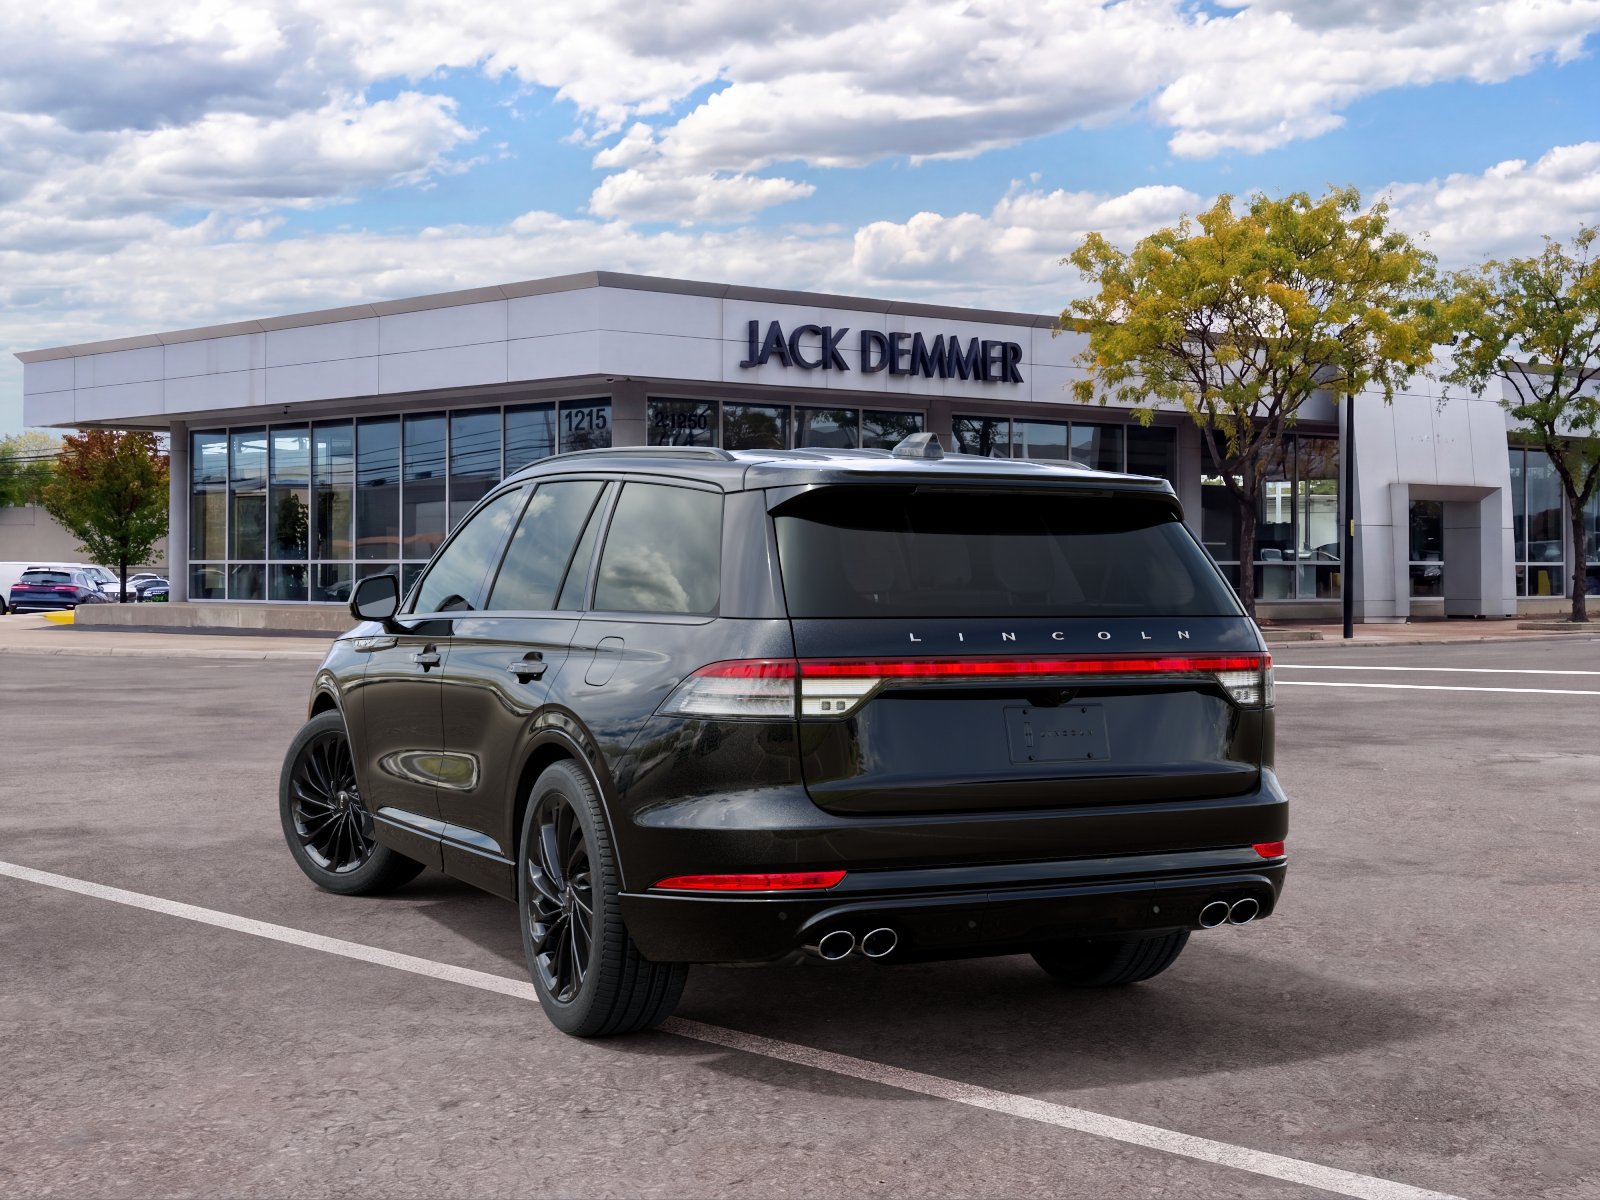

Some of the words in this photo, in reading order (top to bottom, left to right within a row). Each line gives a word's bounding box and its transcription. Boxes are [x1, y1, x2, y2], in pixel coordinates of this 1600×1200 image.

[740, 319, 850, 371] JACK
[861, 329, 1025, 383] DEMMER
[565, 408, 607, 431] 1215
[909, 630, 1190, 642] LINCOLN
